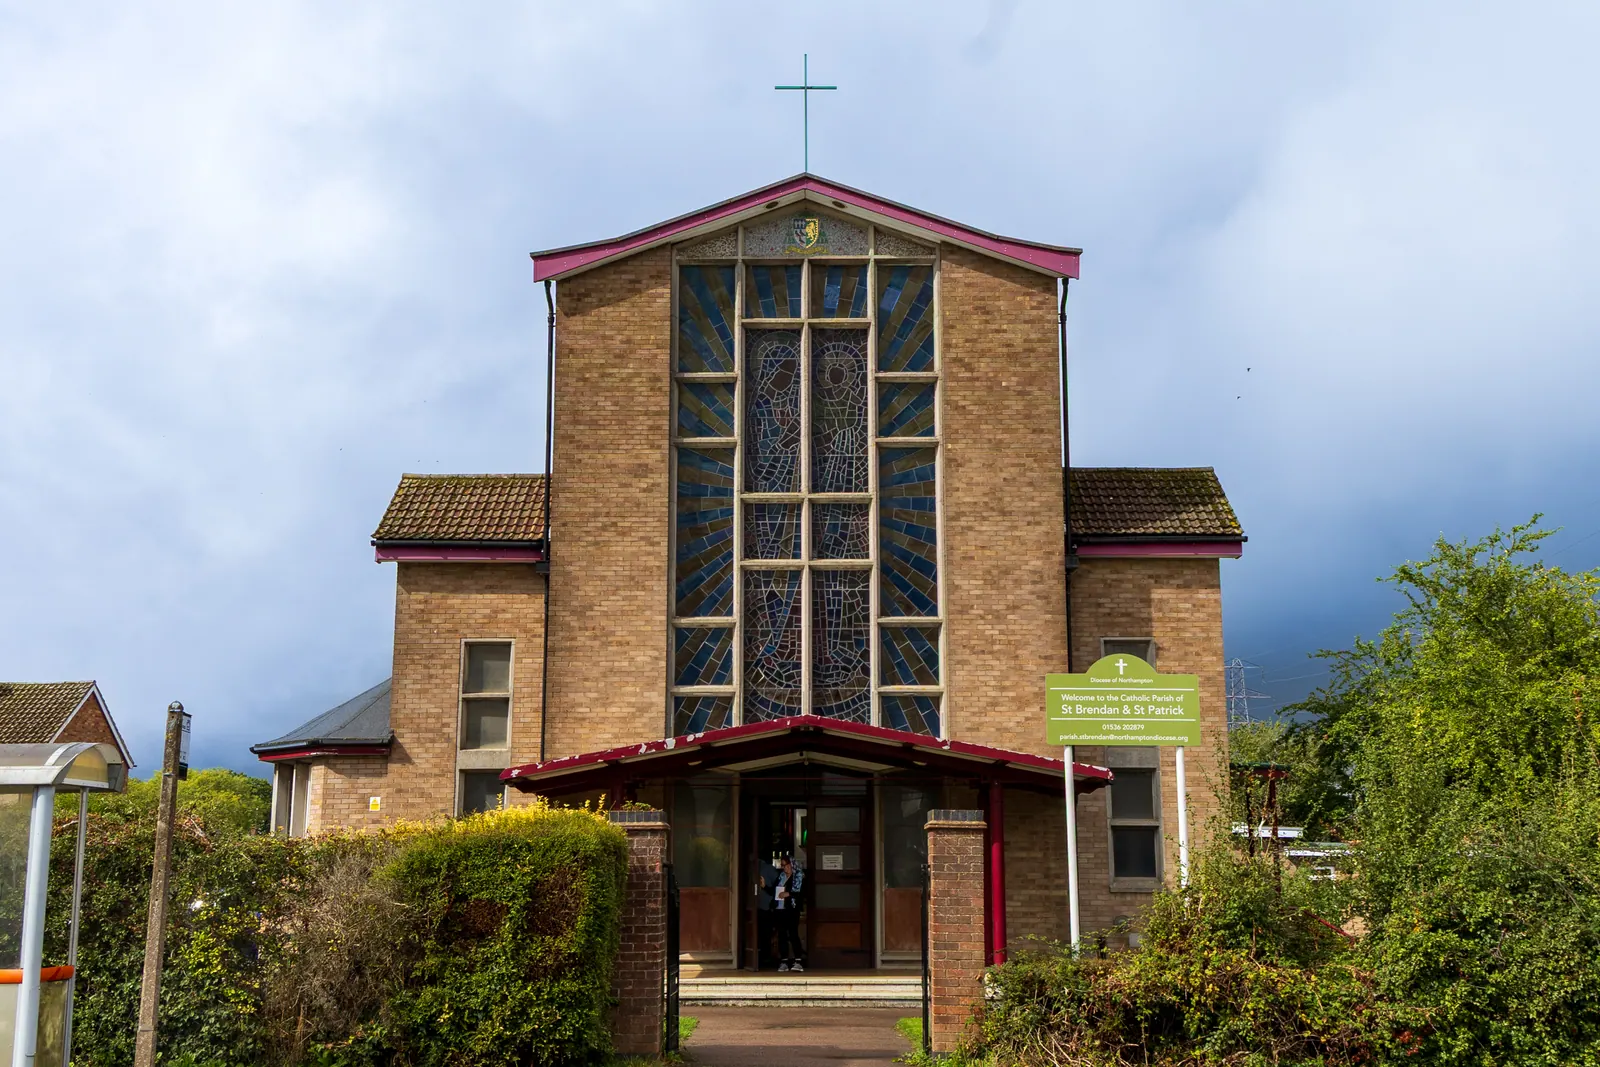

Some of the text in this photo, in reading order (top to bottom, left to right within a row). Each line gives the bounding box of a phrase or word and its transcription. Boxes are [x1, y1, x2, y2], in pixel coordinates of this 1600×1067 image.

[1061, 693, 1184, 702] Welcome to the Catholic Parish of
[1061, 704, 1184, 715] St Brendan & St Patrick
[1102, 723, 1145, 731] 01536 202879
[1059, 733, 1189, 743] parish.stbrendan@northamptondiocese.org
